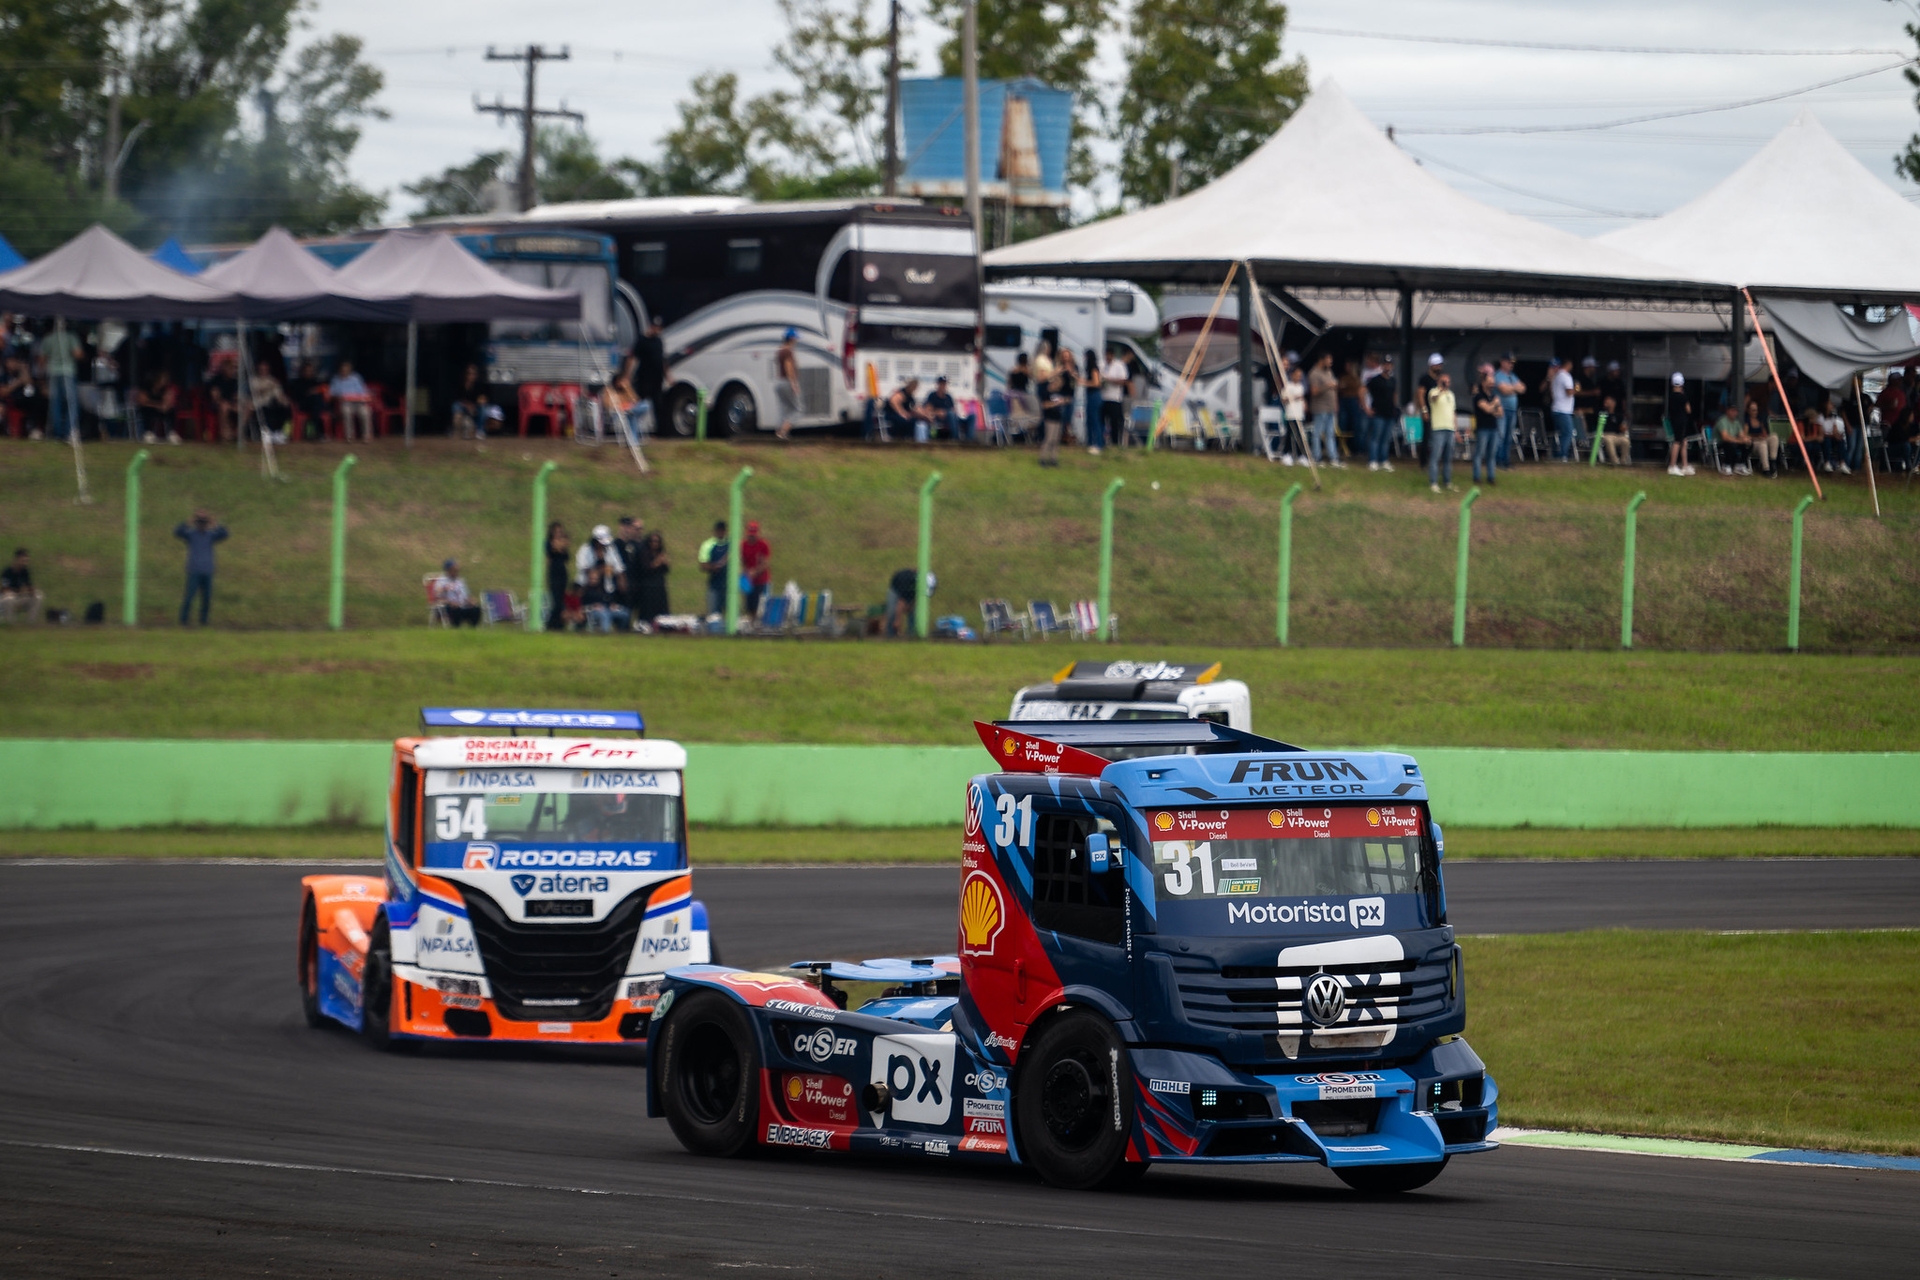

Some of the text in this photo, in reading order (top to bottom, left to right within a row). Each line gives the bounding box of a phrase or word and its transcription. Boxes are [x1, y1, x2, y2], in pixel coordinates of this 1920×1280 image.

[488, 711, 617, 725] atena
[465, 740, 536, 750] ORIGINAL
[1025, 741, 1039, 750] Shell
[465, 752, 553, 763] REMAN FPT
[591, 749, 638, 759] FPT
[1025, 750, 1060, 763] V-Power
[1044, 764, 1059, 773] Diesel
[1228, 758, 1368, 783] FRUM
[1248, 784, 1365, 796] METEOR
[1178, 811, 1196, 819] Shell
[1286, 808, 1303, 817] Shell
[1381, 807, 1395, 816] Shell
[436, 796, 488, 840] 54
[995, 793, 1032, 847] 31
[1287, 817, 1329, 828] V-Power
[1382, 816, 1416, 826] V-Power
[1179, 820, 1227, 830] V-Power
[1209, 832, 1228, 840] Diesel
[1313, 830, 1331, 838] Diesel
[1404, 828, 1418, 836] Diesel
[501, 850, 651, 867] RODOBRAS
[1094, 852, 1105, 861] px
[1162, 841, 1215, 895] 31
[539, 871, 608, 893] atena
[1231, 884, 1258, 892] ELITE
[533, 902, 586, 914] IVECO
[1228, 901, 1381, 925] Motorista px
[807, 1010, 836, 1021] Business
[794, 1028, 858, 1062] CISER
[806, 1079, 823, 1089] Shell
[887, 1053, 943, 1112] px
[1295, 1073, 1385, 1086] CISER
[1109, 1047, 1122, 1131] PROMETEON
[1151, 1081, 1189, 1093] MAHLE
[1323, 1085, 1372, 1094] PROMETEON
[805, 1090, 847, 1107] V-Power
[829, 1110, 847, 1121] Diesel
[970, 1119, 1004, 1133] FRUM
[767, 1124, 835, 1149] EMBREAGEX
[925, 1142, 950, 1154] BRASIL
[976, 1140, 1001, 1151] Shopee
